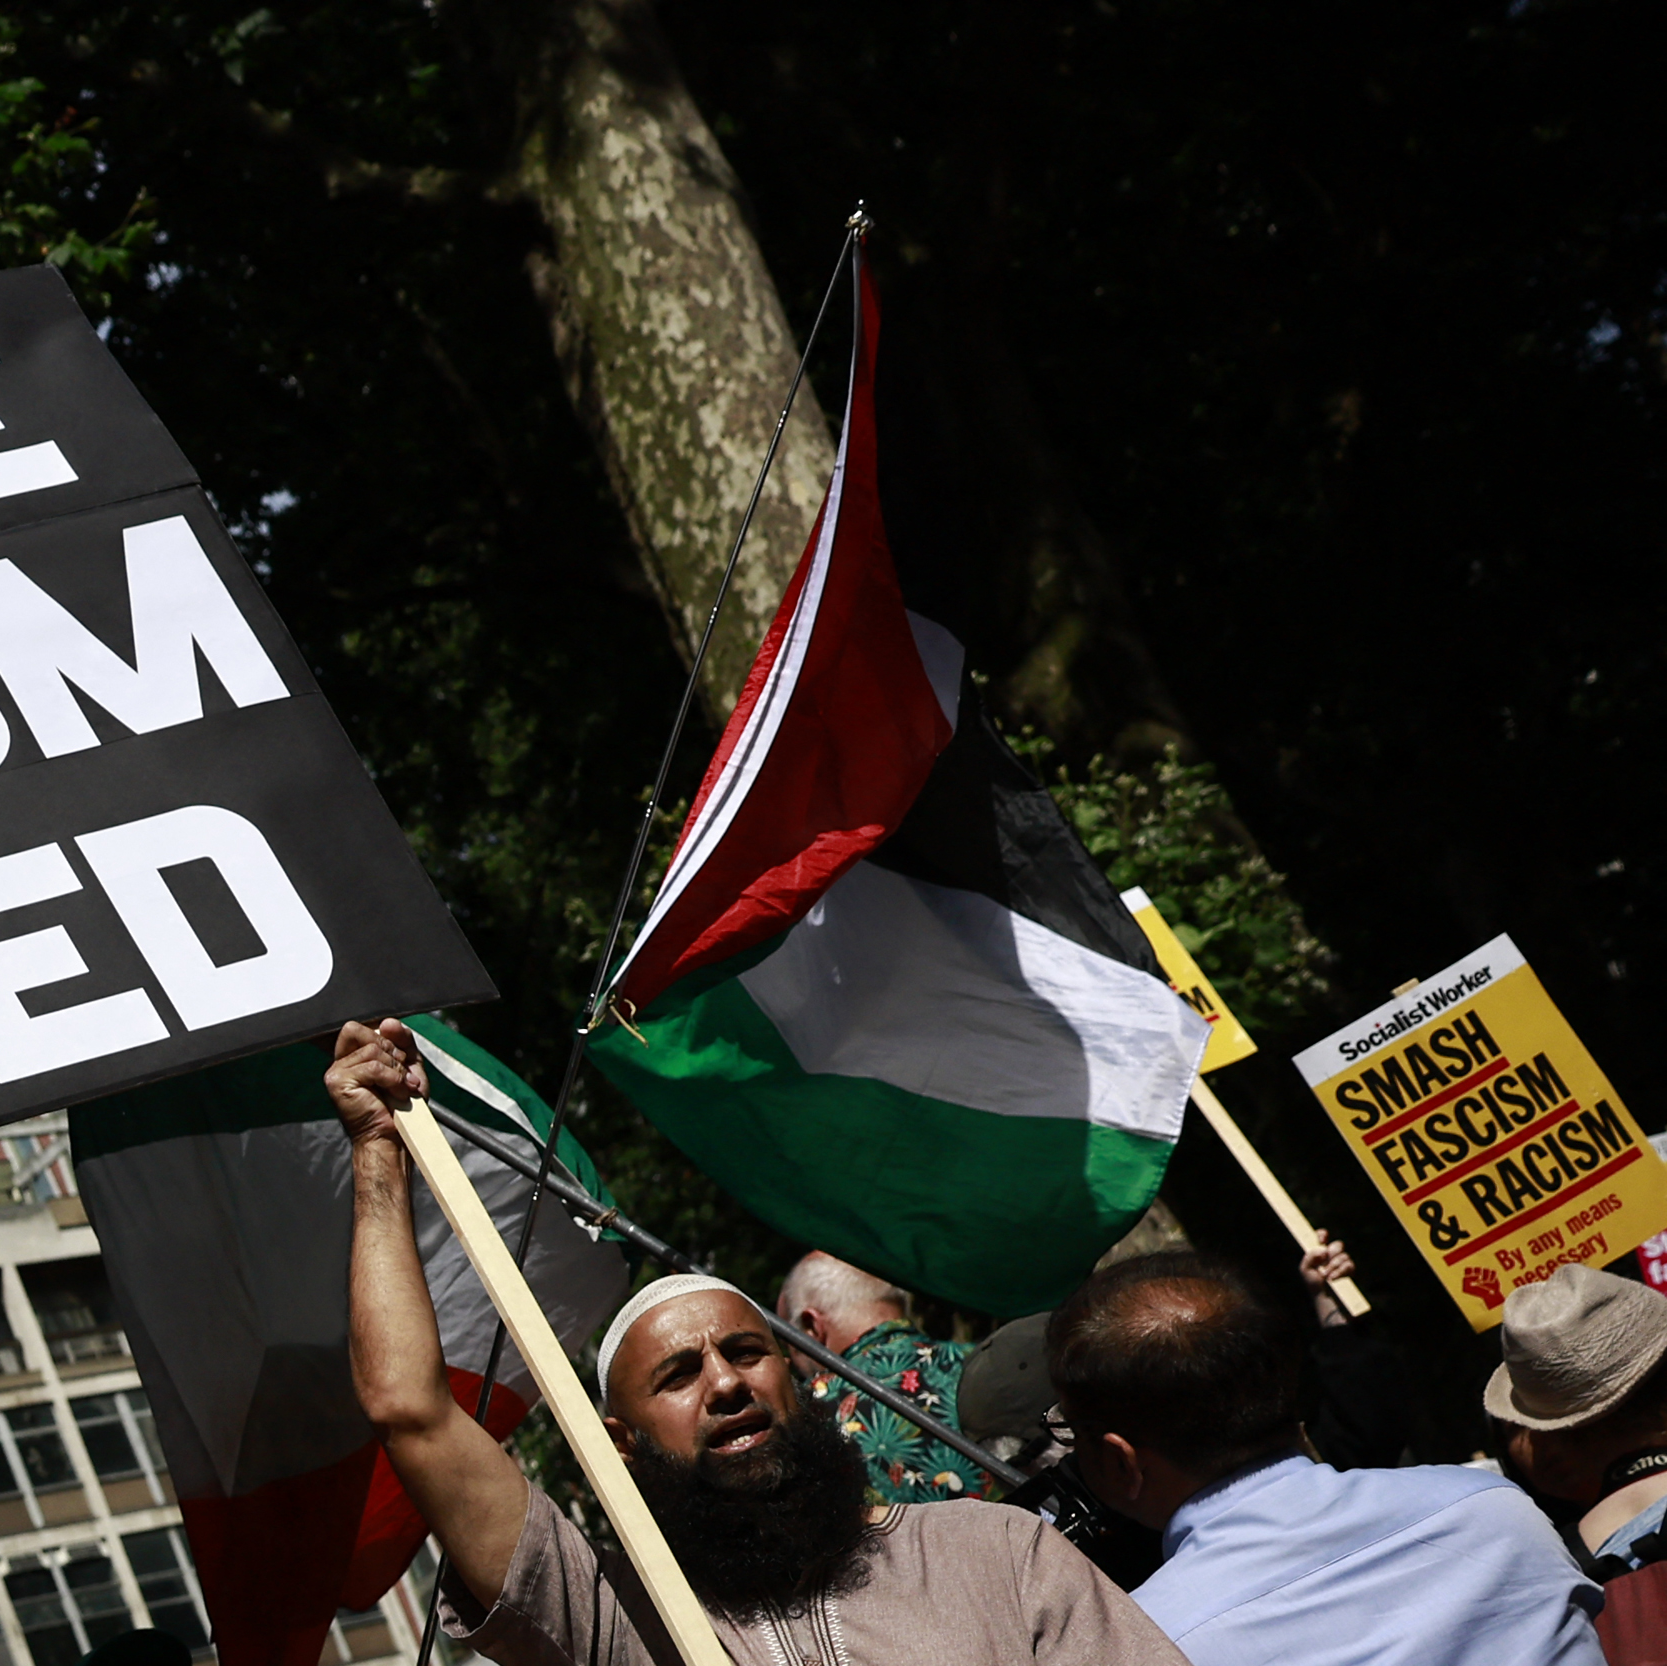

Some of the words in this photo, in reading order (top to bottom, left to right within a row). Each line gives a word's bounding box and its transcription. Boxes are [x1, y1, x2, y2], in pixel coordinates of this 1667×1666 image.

[1335, 1009, 1502, 1131] SMASH
[1371, 1052, 1571, 1192] FASCISM
[1417, 1200, 1470, 1250] &
[1461, 1100, 1634, 1227] RACISM
[1494, 1245, 1527, 1272] By
[1527, 1225, 1566, 1256] any
[1566, 1192, 1623, 1236] means
